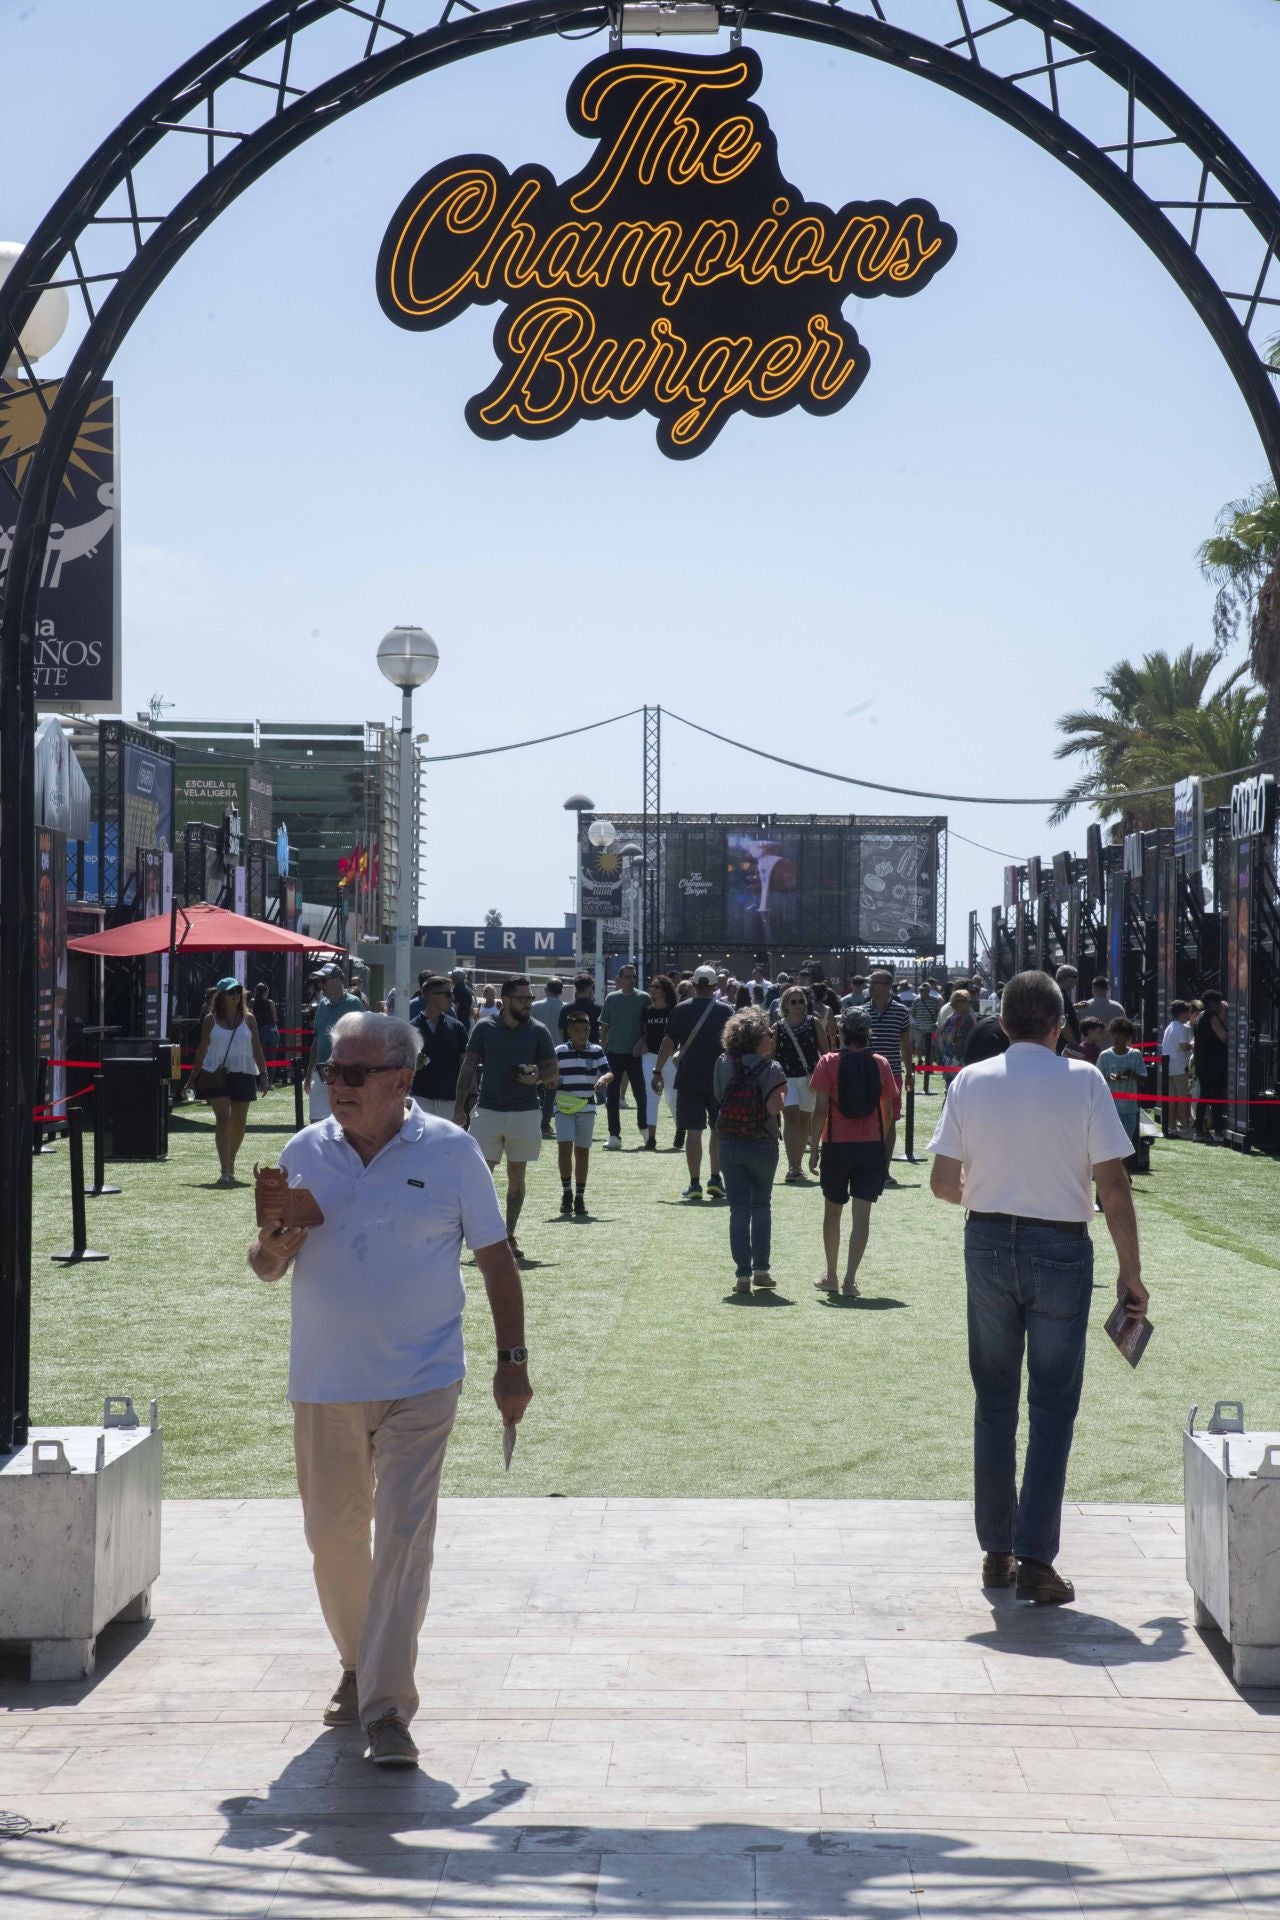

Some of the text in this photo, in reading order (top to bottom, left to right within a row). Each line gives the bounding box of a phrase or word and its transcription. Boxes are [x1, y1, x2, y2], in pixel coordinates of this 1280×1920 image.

[571, 63, 762, 213] The
[391, 169, 942, 315] Champions
[480, 297, 855, 445] Burger
[184, 789, 238, 797] VELA LIGERA
[185, 780, 225, 788] ESCUELA
